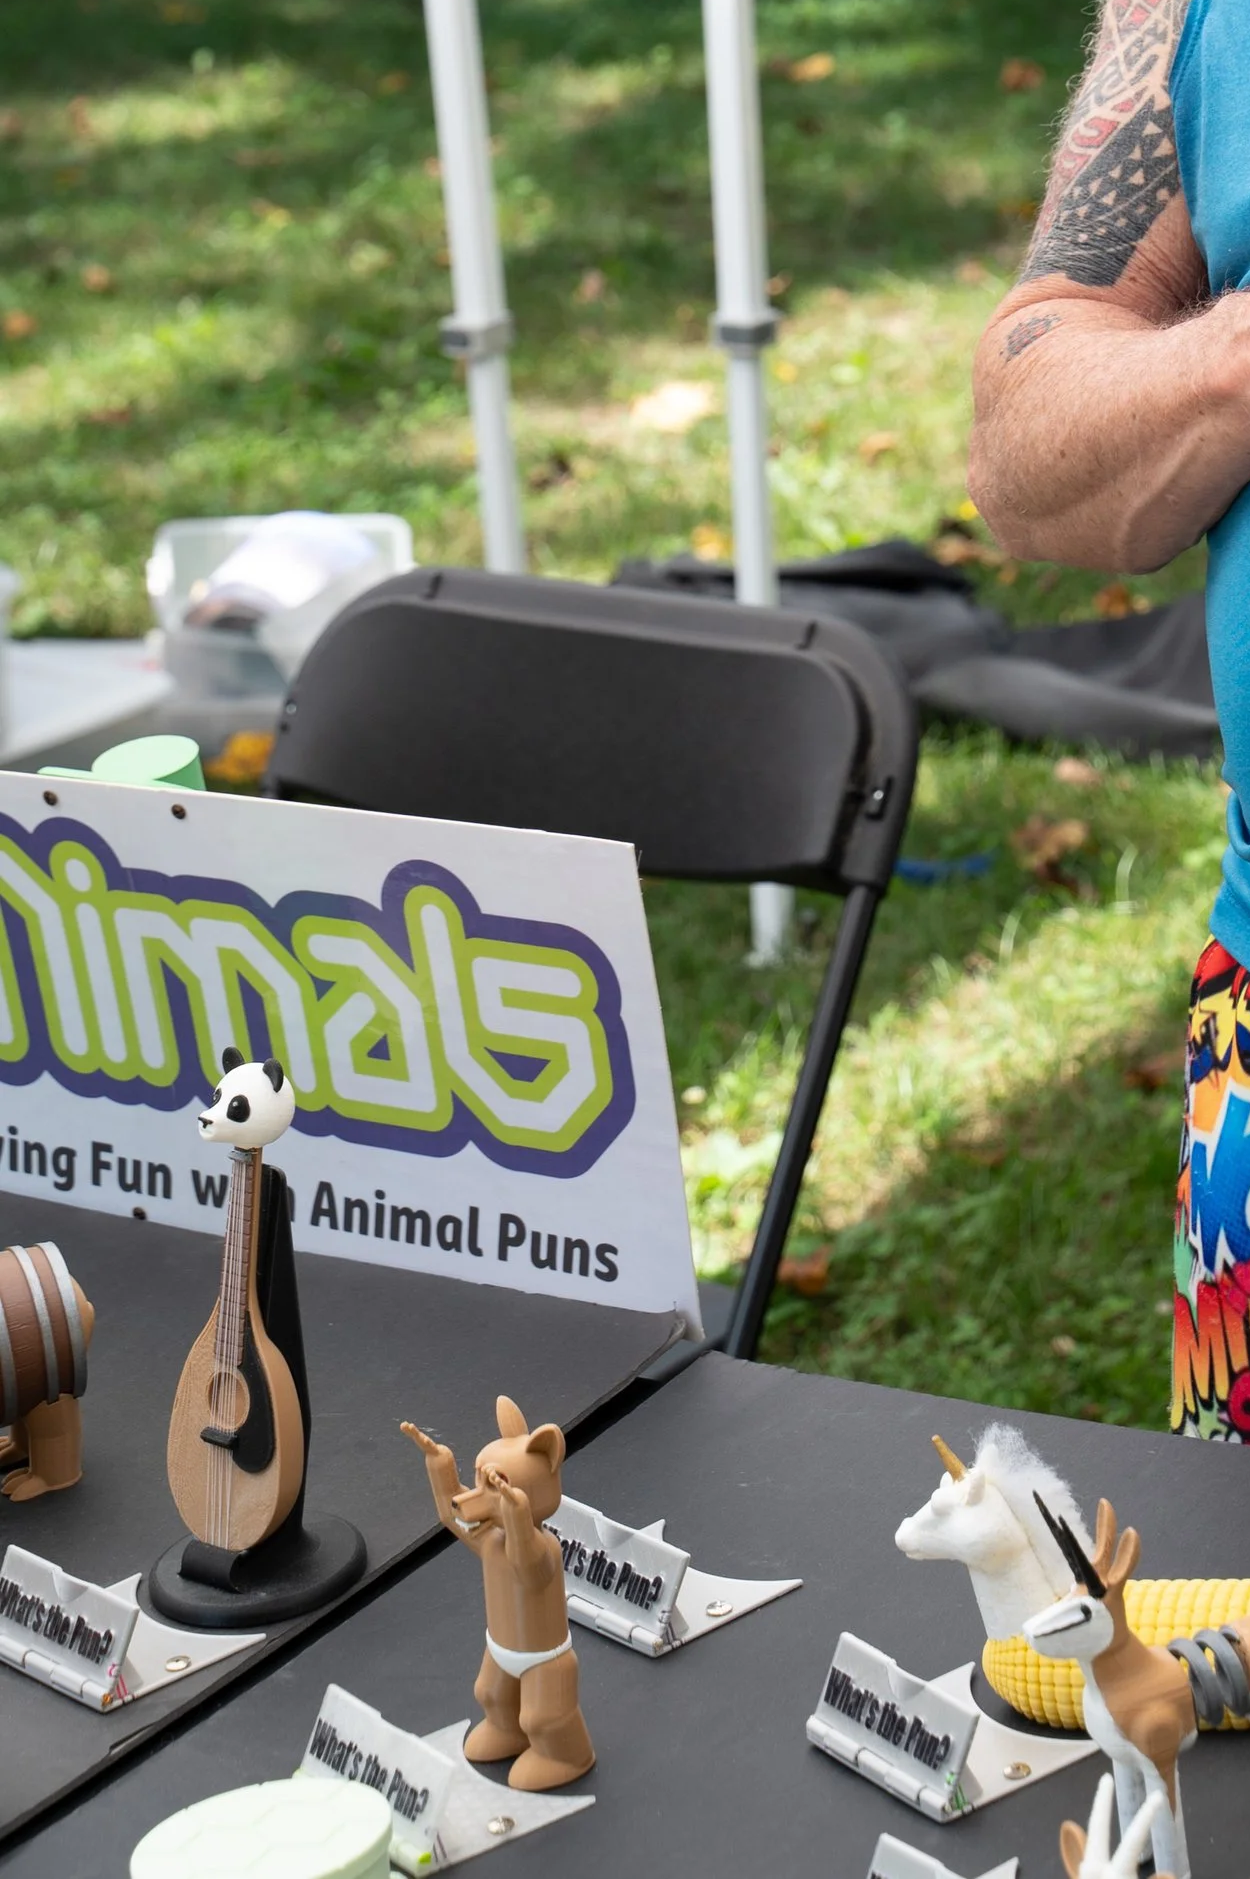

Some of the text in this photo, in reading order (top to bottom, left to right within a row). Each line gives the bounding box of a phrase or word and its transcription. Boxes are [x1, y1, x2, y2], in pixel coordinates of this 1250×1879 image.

[91, 1141, 172, 1199] Fun
[310, 1182, 483, 1258] Animal
[499, 1214, 619, 1284] Puns
[586, 1550, 617, 1591] the
[614, 1562, 663, 1610] Pun?
[43, 1605, 70, 1645] the
[68, 1615, 113, 1663] Pun?
[824, 1666, 951, 1770] What's the Pun?
[309, 1718, 363, 1781] What's
[386, 1768, 430, 1823] Pun?
